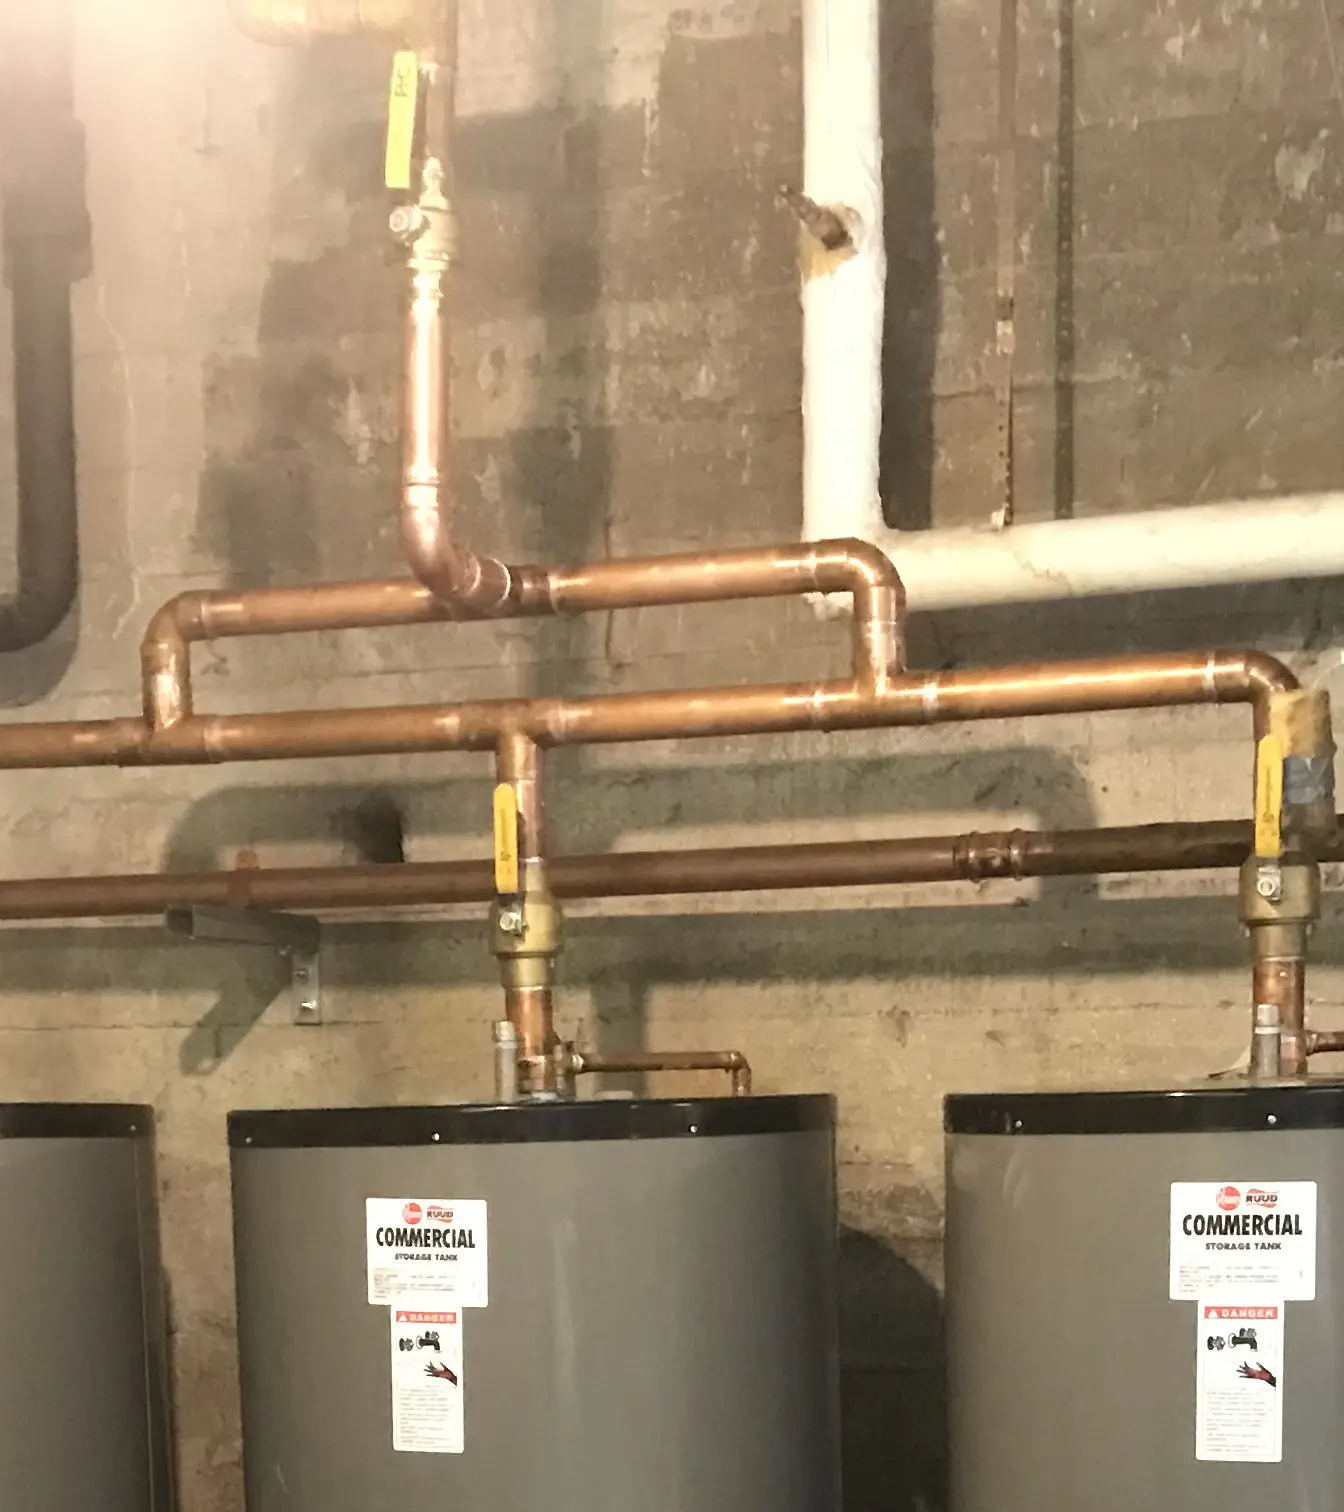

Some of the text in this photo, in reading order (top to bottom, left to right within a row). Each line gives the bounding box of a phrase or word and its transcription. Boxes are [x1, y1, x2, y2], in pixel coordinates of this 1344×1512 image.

[1245, 1194, 1279, 1203] RUUD
[426, 1210, 454, 1219] RUUD
[1182, 1213, 1303, 1236] COMMERCIAL
[375, 1227, 476, 1249] COMMERCIAL
[1205, 1242, 1282, 1251] STORAGE TANK
[394, 1253, 459, 1262] STORAGE TANK
[409, 1312, 454, 1323] DANGER
[1220, 1308, 1275, 1319] DANGER
